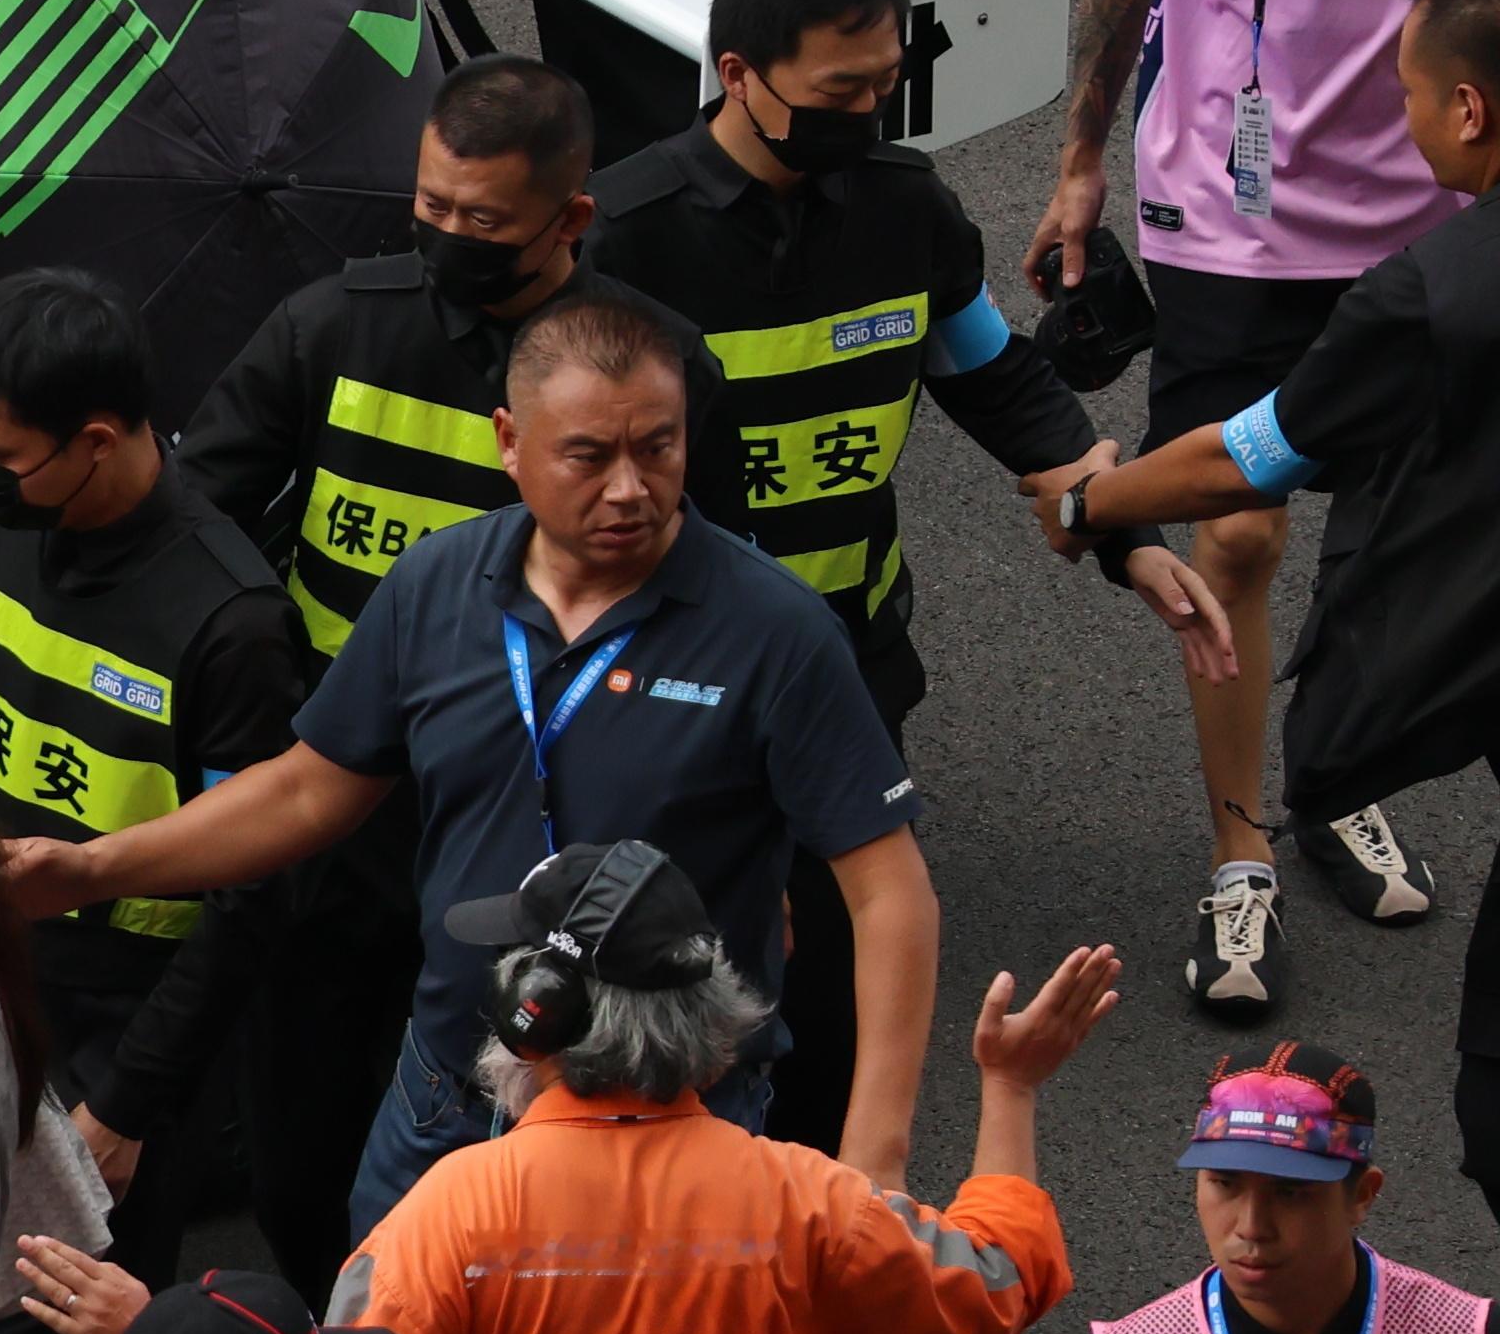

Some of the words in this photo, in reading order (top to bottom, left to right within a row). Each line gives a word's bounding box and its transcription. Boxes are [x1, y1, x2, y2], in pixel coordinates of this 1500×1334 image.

[835, 327, 870, 348] GRID
[874, 321, 913, 342] GRID
[1227, 421, 1258, 472] CIAL
[93, 673, 122, 696] GRID
[126, 688, 161, 711] GRID
